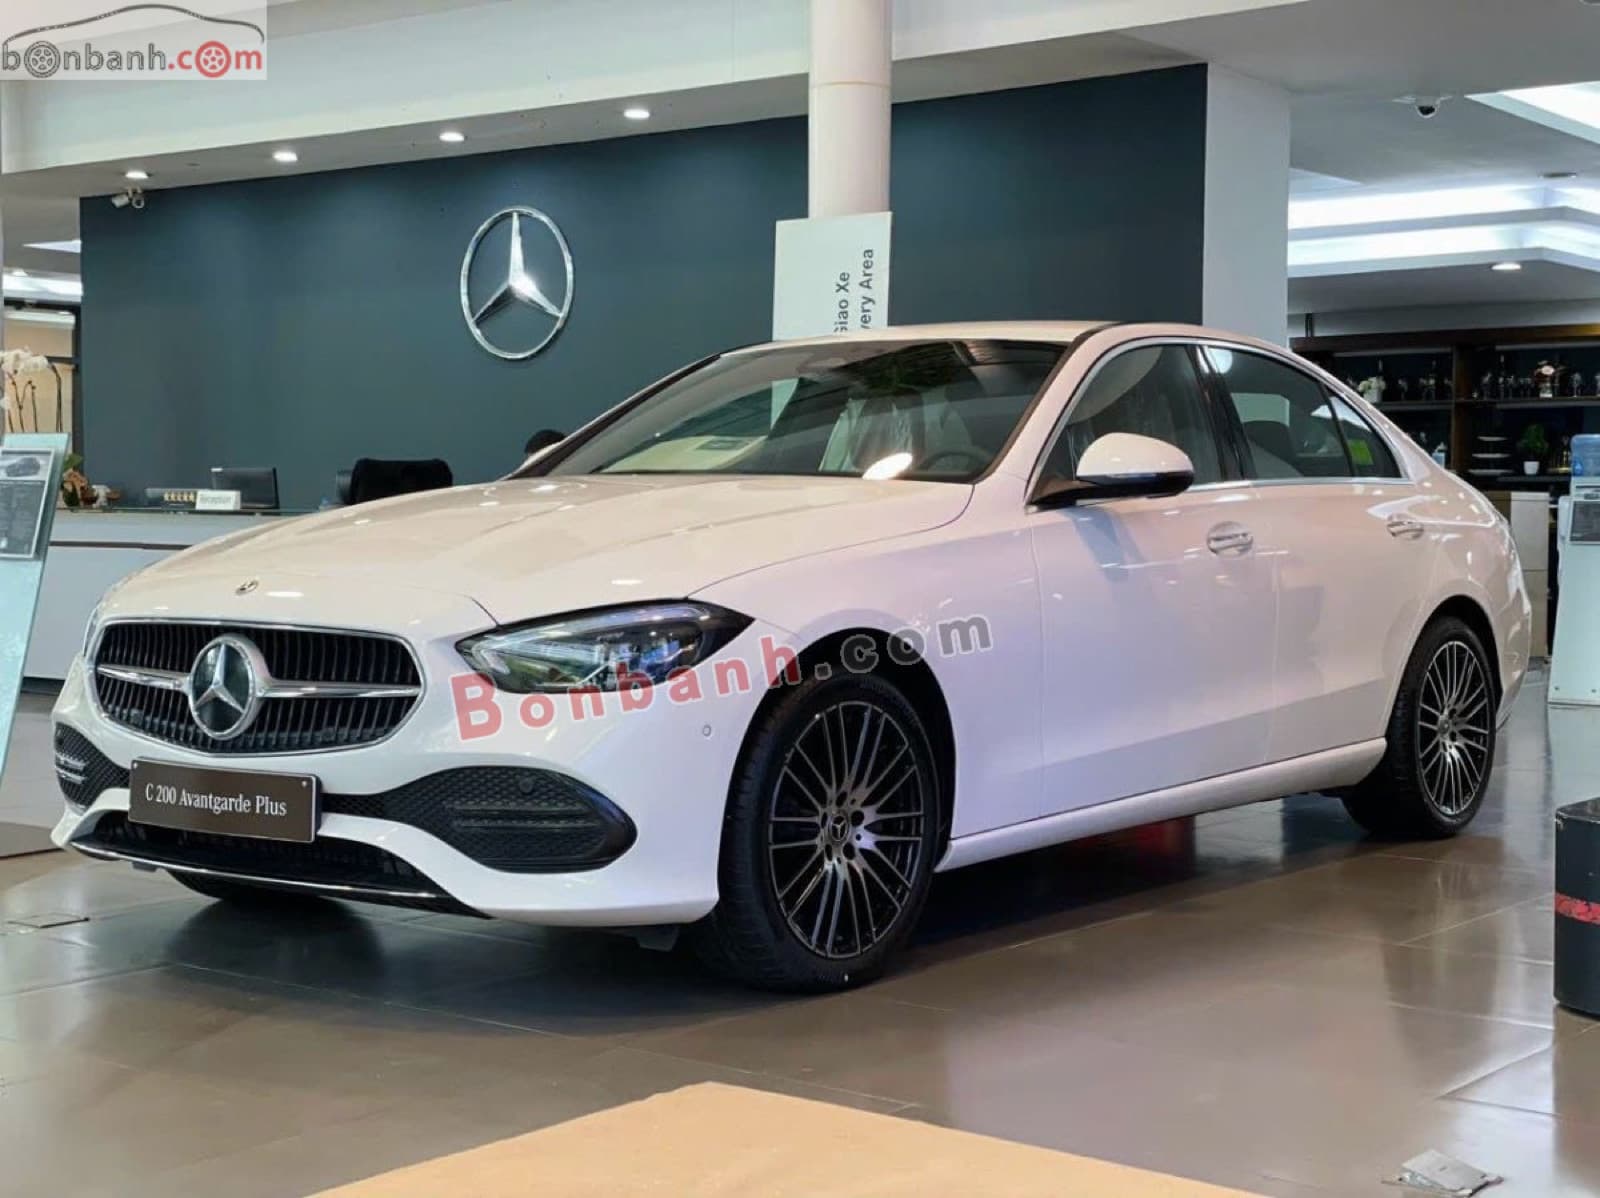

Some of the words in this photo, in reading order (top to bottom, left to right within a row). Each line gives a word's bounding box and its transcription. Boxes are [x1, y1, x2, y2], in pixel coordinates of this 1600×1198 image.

[835, 271, 850, 293] Xe
[859, 248, 874, 290] Area
[145, 783, 154, 801] C
[156, 785, 177, 805] 200
[178, 789, 252, 815] Avantgarde
[255, 795, 287, 817] Plus
